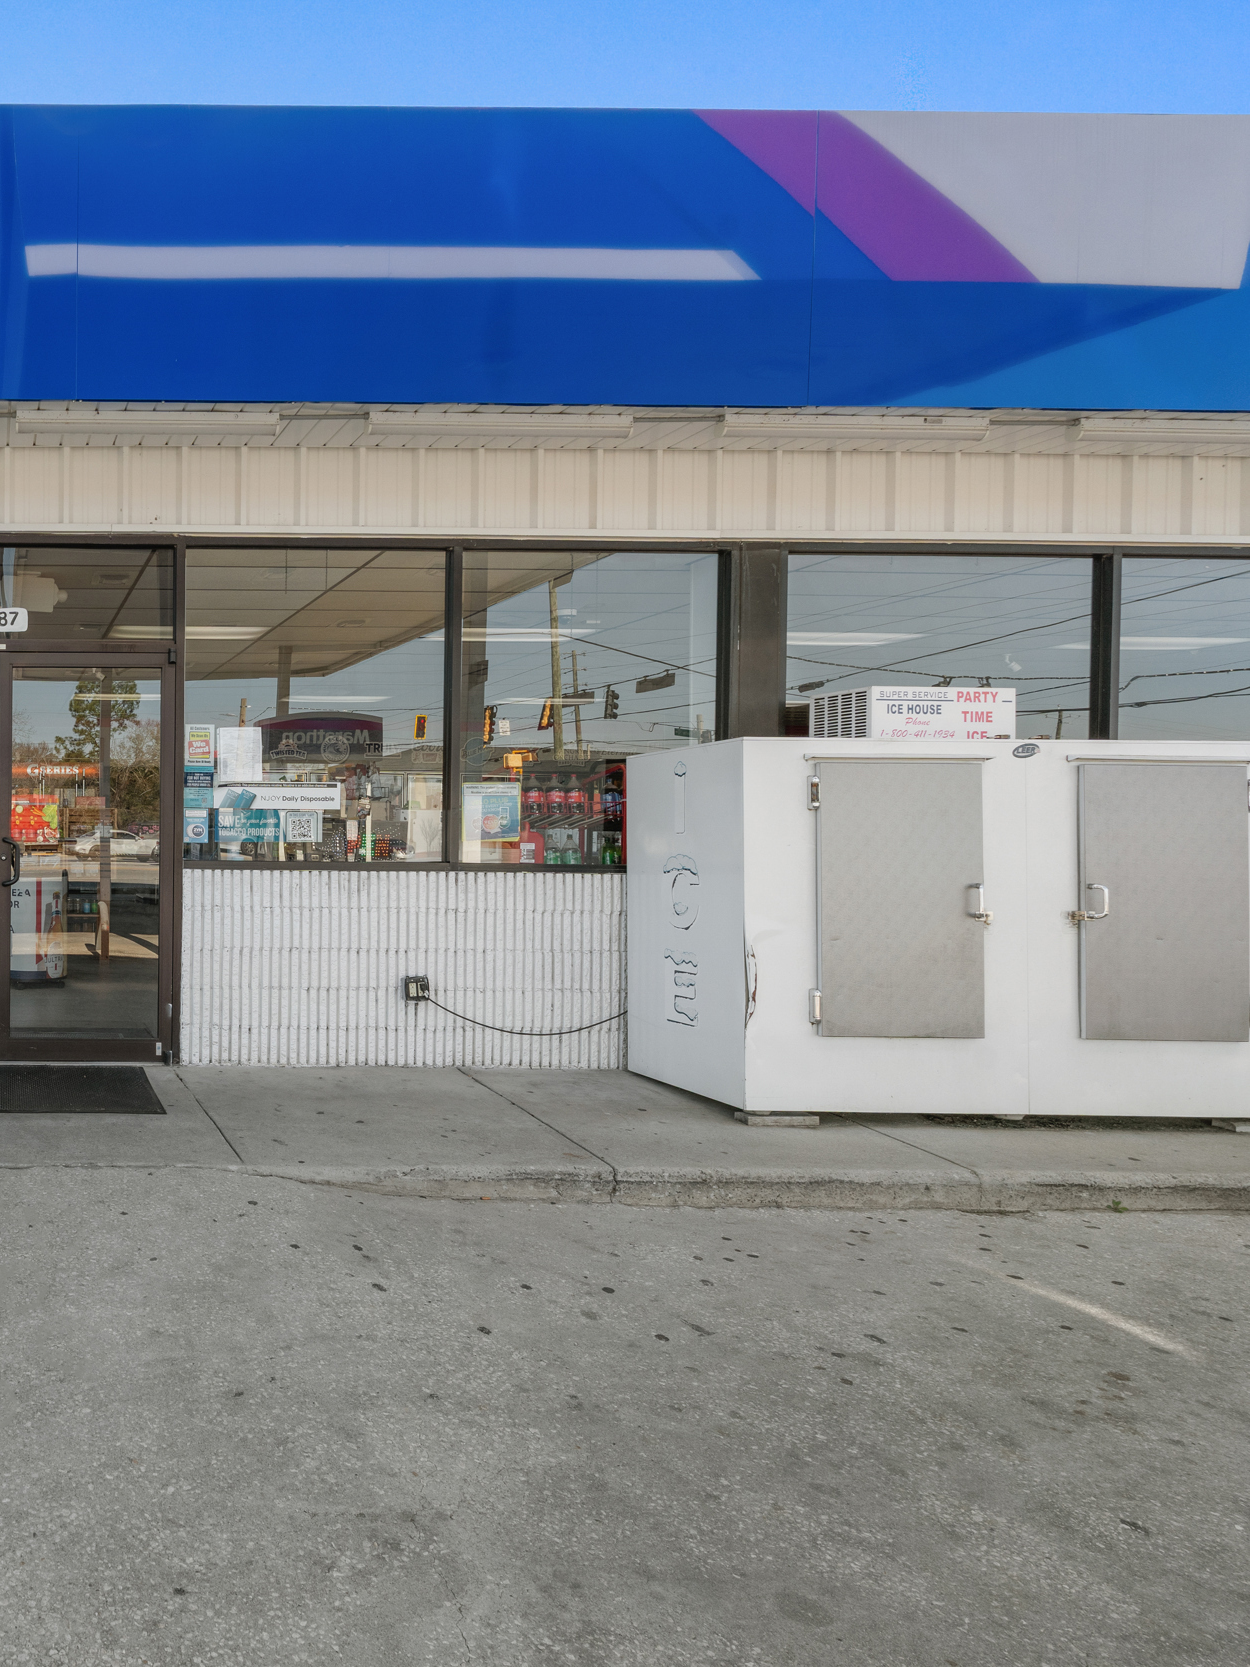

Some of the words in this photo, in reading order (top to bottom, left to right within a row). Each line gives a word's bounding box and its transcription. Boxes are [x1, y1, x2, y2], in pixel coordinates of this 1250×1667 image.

[879, 690, 909, 699] SUPER
[911, 691, 949, 699] SERVICE
[956, 690, 999, 703] PARTY
[886, 703, 904, 715] ICE
[907, 704, 942, 715] HOUSE
[961, 710, 993, 723] TIME
[905, 717, 931, 726] Phone
[880, 729, 955, 738] 1-800-411-1934
[190, 746, 210, 754] Card
[1016, 746, 1036, 754] LEER
[282, 795, 299, 803] Daily
[300, 795, 336, 803] Disposable
[218, 815, 240, 828] SAVE
[218, 827, 247, 837] TOBACCO
[247, 827, 280, 837] PRODUCTS
